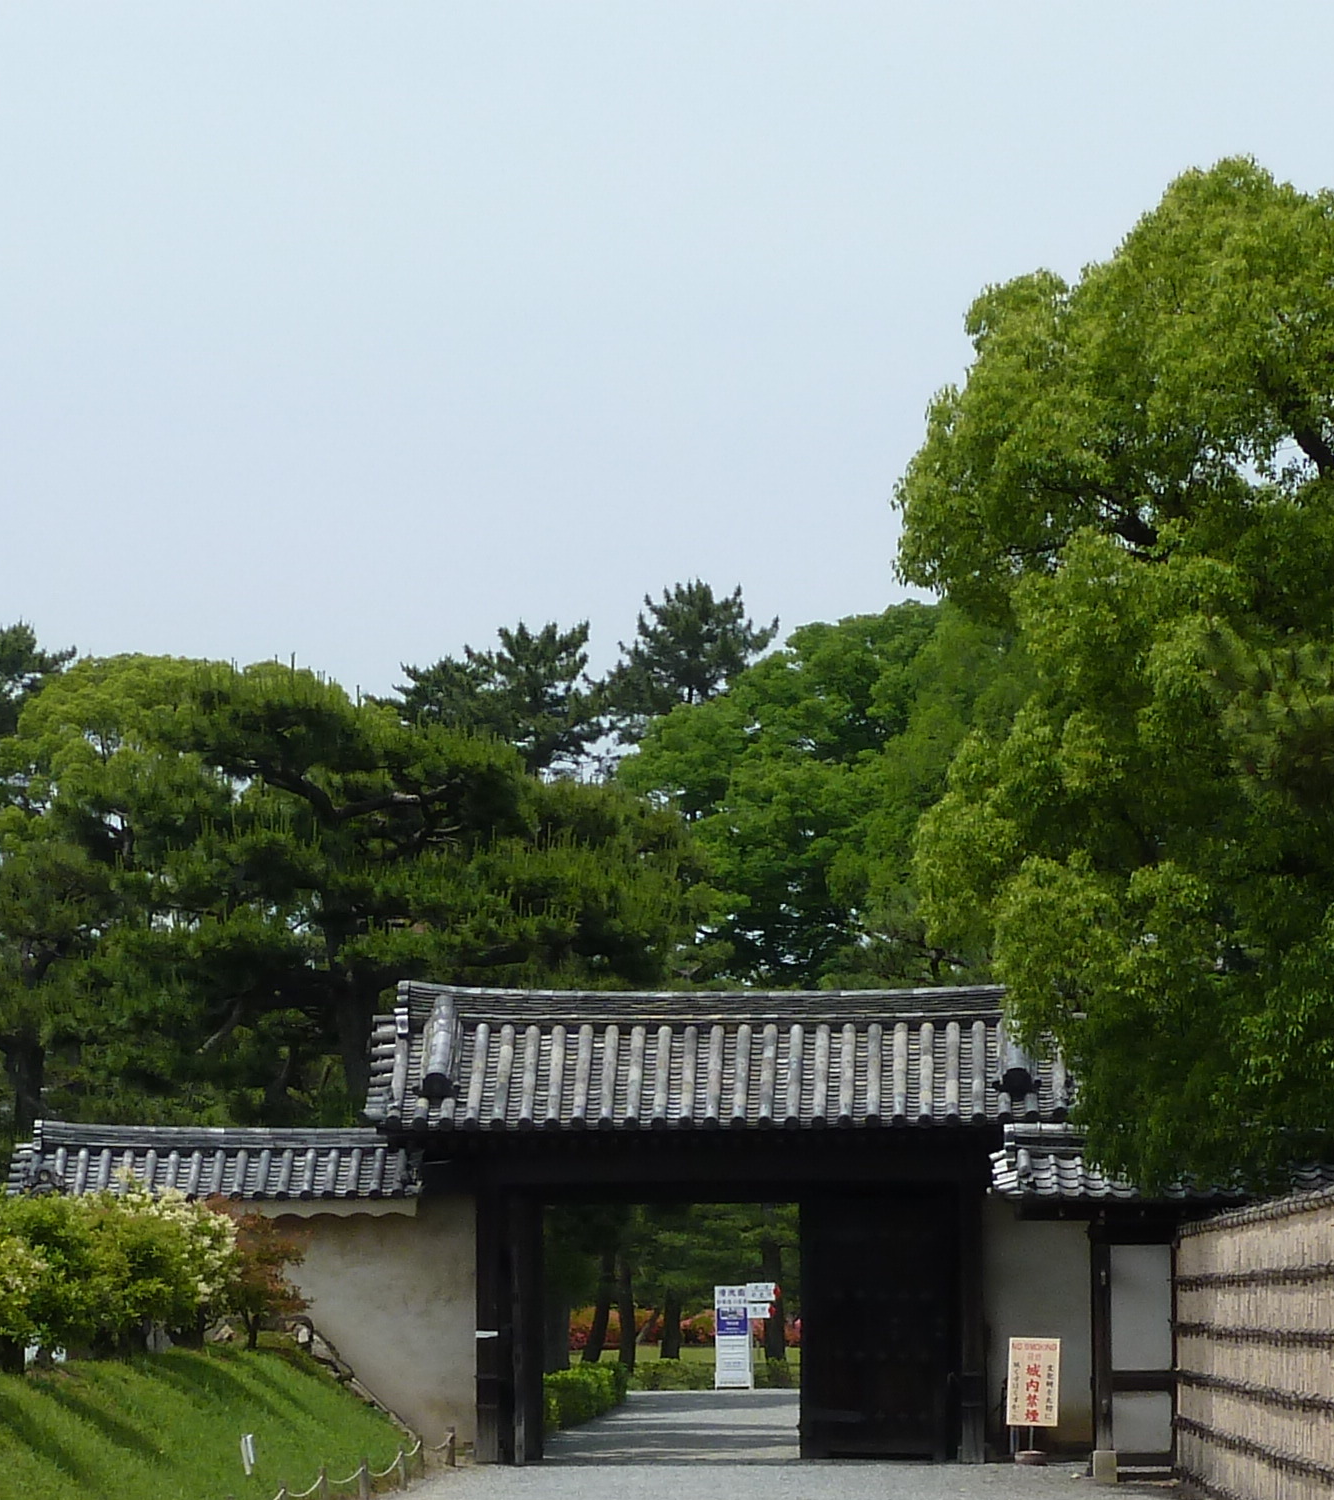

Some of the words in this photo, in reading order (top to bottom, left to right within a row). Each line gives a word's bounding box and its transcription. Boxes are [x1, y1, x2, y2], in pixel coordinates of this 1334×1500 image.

[1025, 1343, 1057, 1351] SMOKING
[1025, 1363, 1041, 1422] 城内禁煙
